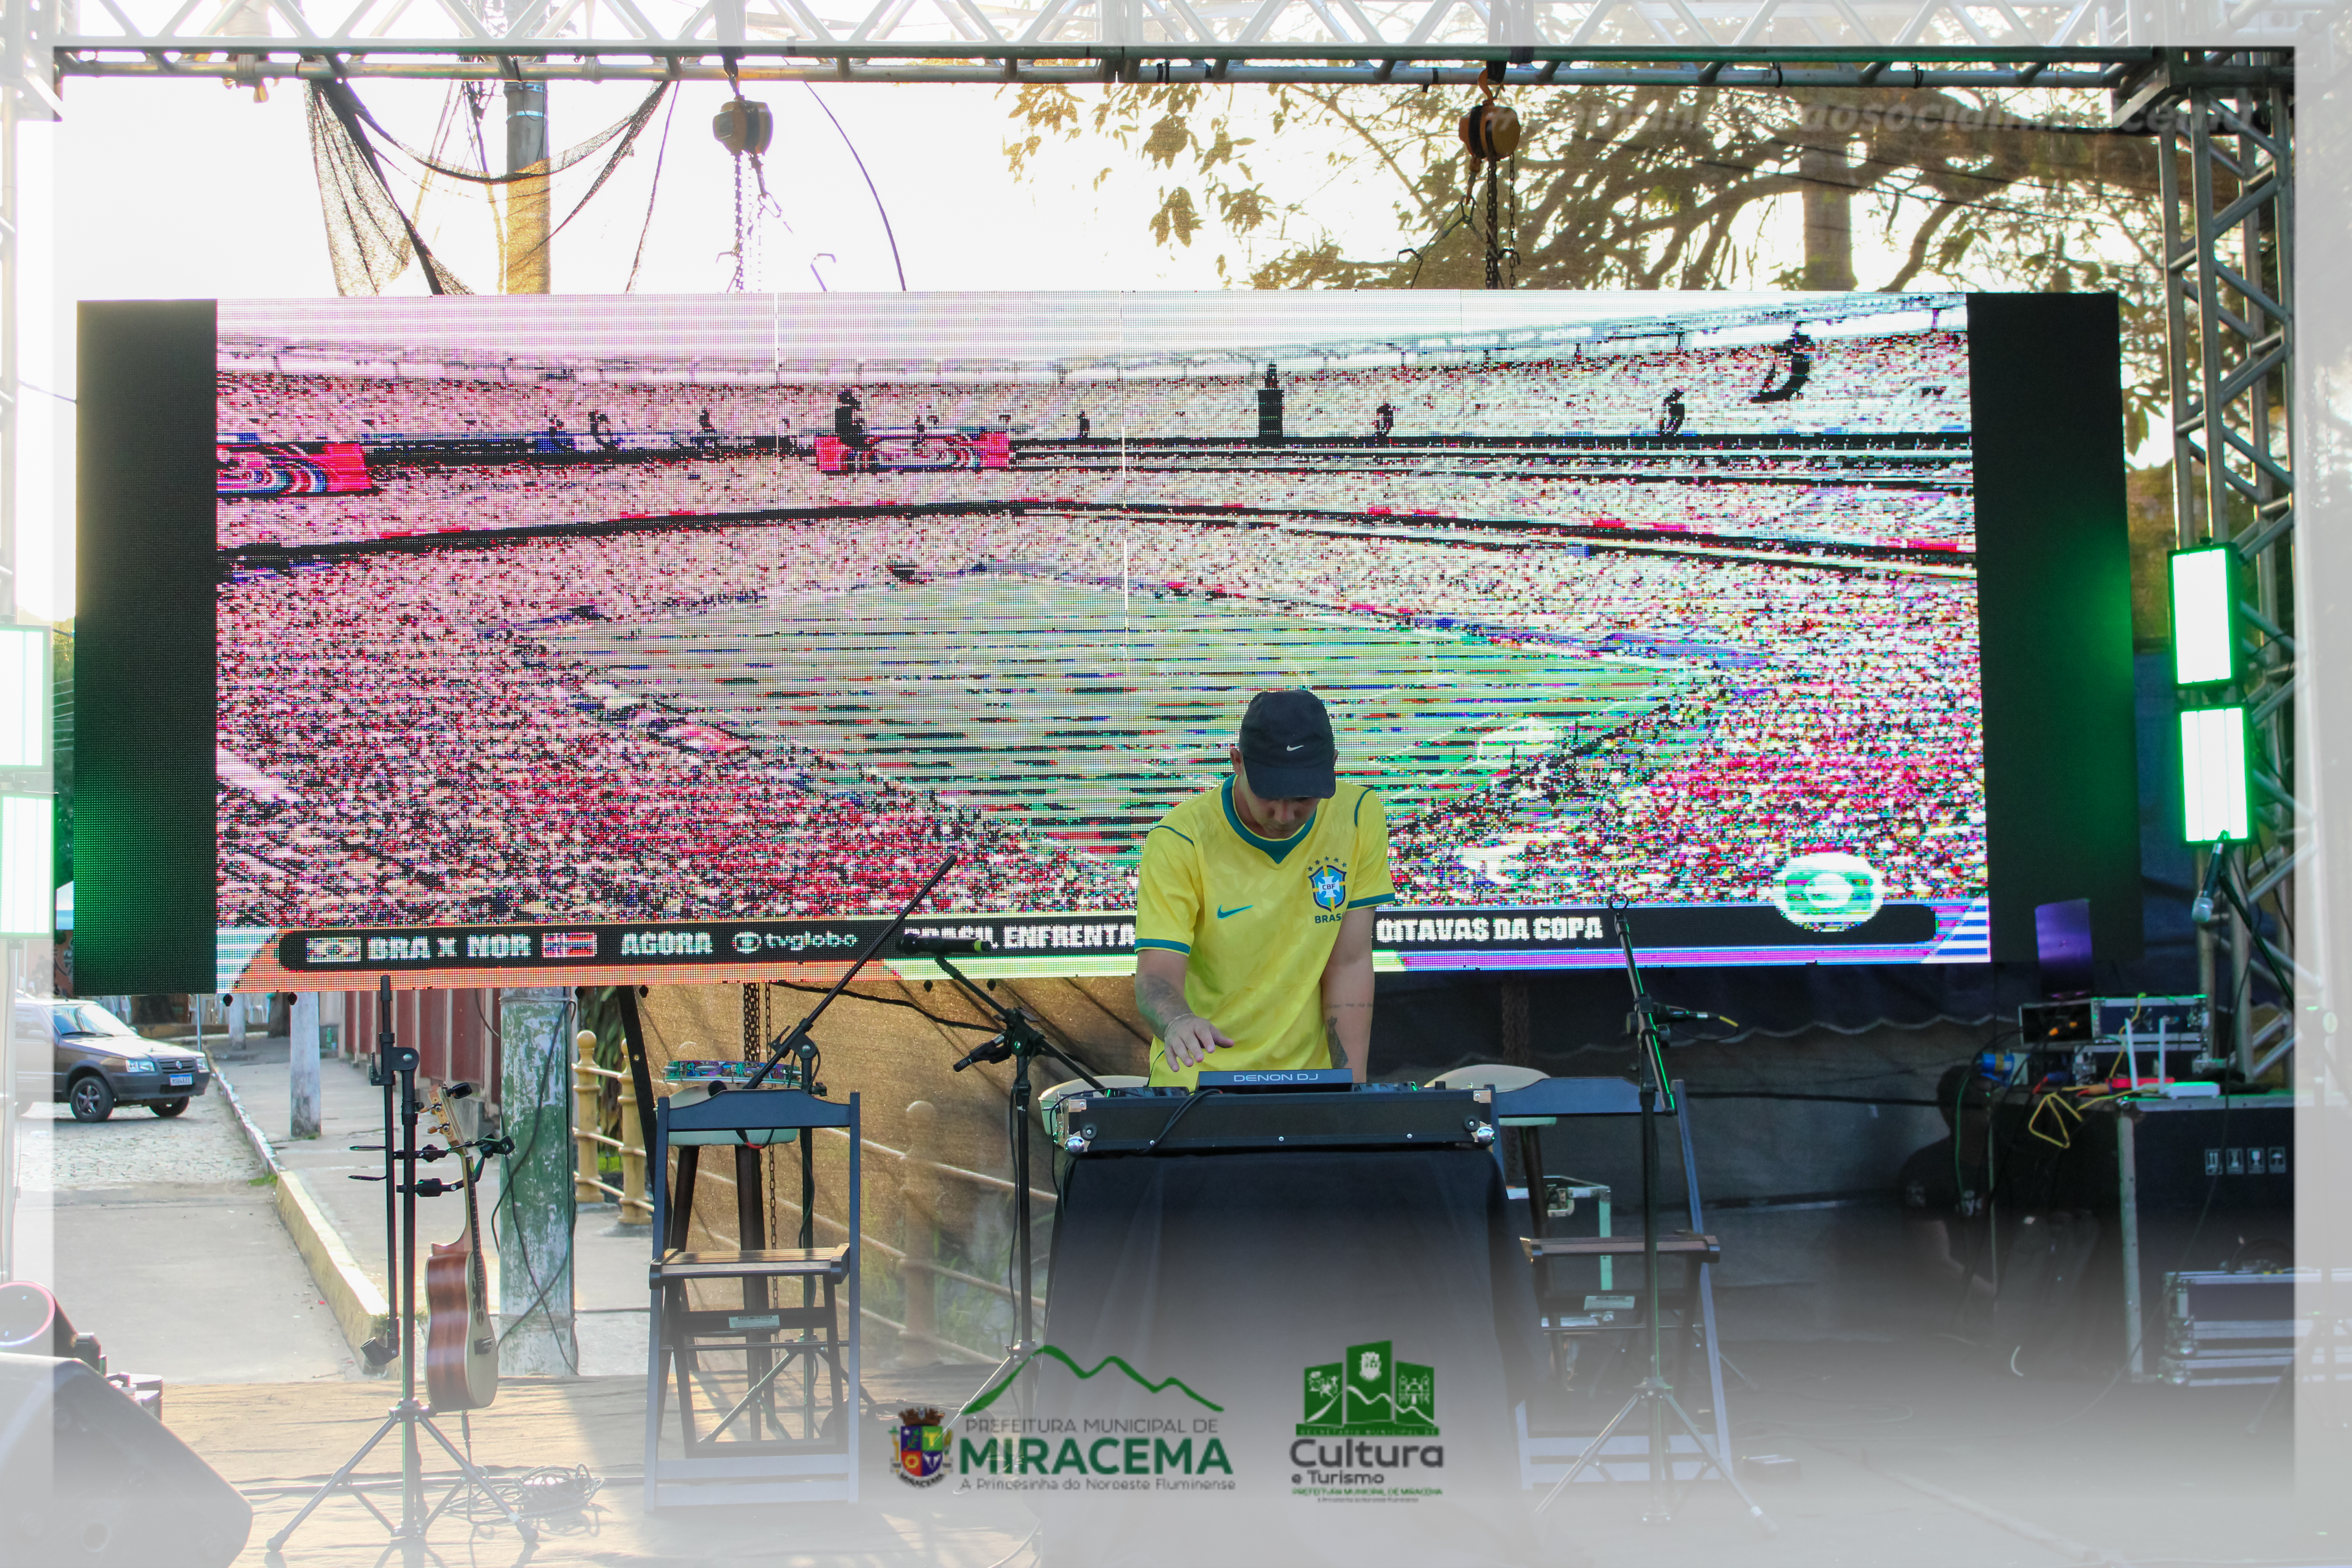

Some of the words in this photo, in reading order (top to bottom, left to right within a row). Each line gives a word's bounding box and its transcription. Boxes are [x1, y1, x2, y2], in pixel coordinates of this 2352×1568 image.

[1315, 913, 1342, 924] BRAS
[1376, 917, 1490, 943] OITAVAS
[1493, 917, 1530, 941] DA
[1533, 916, 1603, 941] COPA
[367, 936, 431, 960] BRA
[467, 934, 531, 958] NOR
[621, 931, 713, 956] AGORA
[1003, 923, 1135, 949] ENFRENTA
